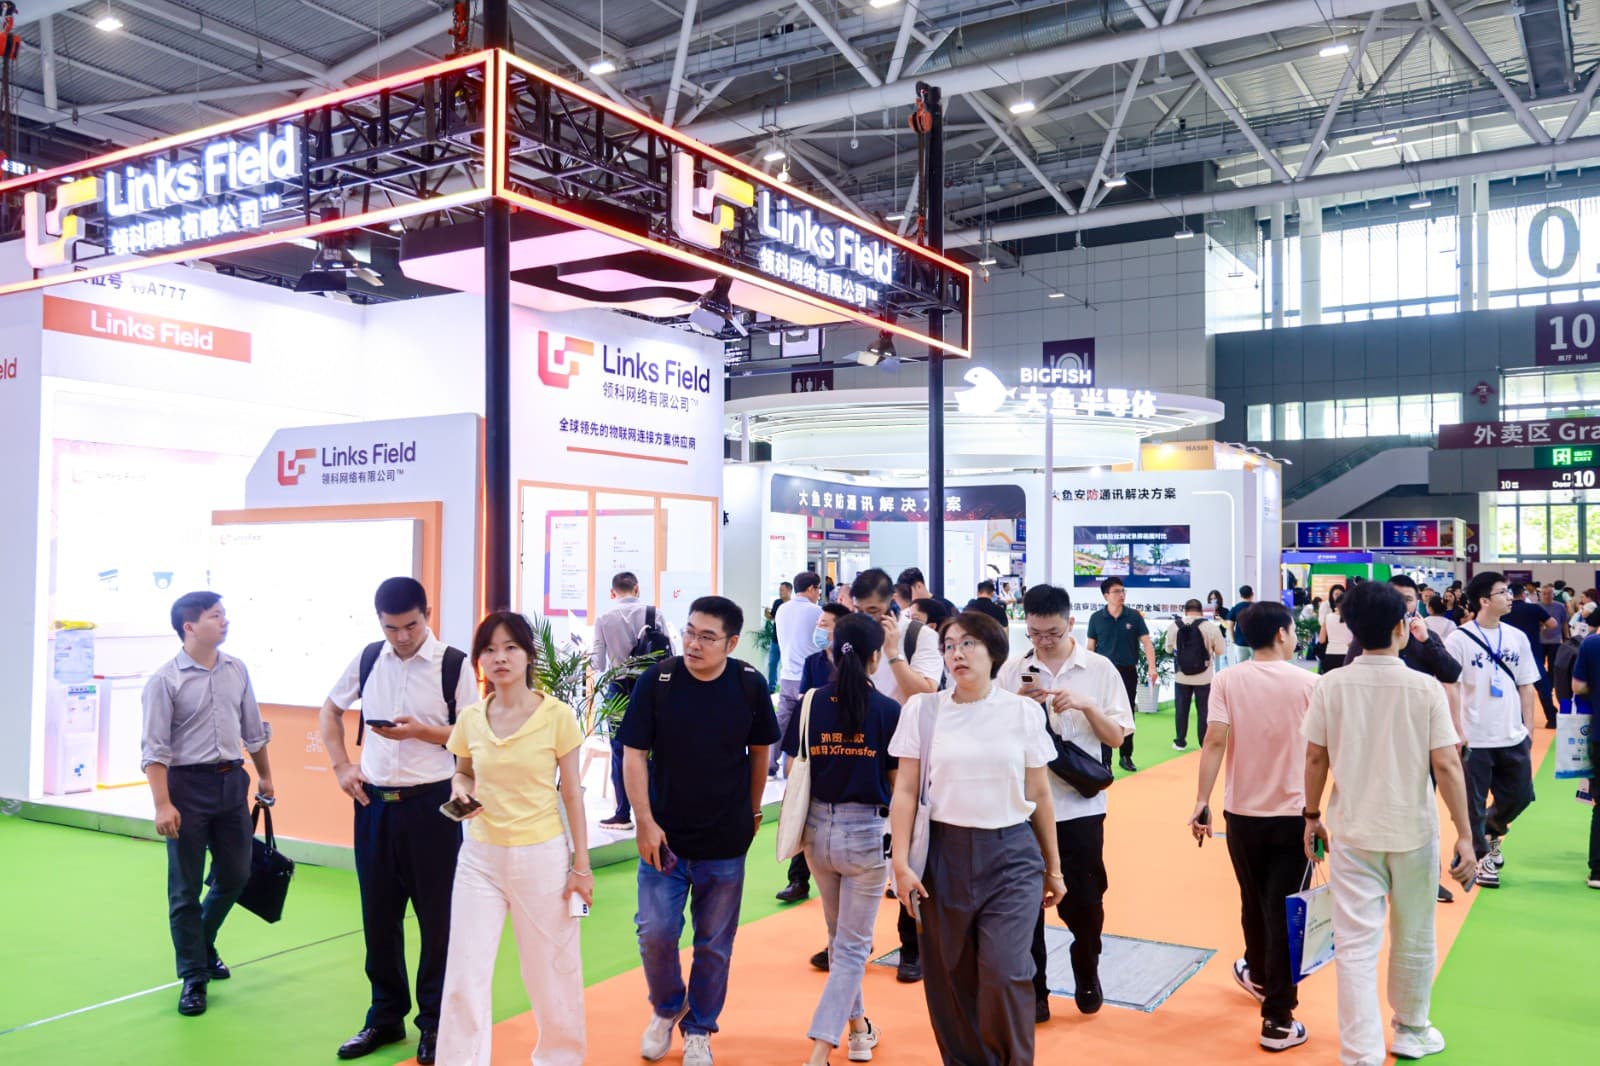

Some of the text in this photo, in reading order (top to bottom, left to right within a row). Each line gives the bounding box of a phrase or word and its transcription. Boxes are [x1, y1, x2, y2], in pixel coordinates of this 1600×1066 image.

[106, 122, 298, 216] Links Field
[757, 189, 893, 286] Links Field
[90, 309, 214, 352] Links Field
[1549, 313, 1596, 351] 10
[603, 344, 711, 394] Links Field
[1020, 367, 1093, 385] BIGFISH
[1019, 385, 1157, 419] 大鱼半导体
[559, 416, 696, 451] 全球领先的物联网连接方案供应商
[1473, 422, 1552, 446] 外卖区
[322, 440, 417, 468] Links Field
[1573, 469, 1596, 487] 10
